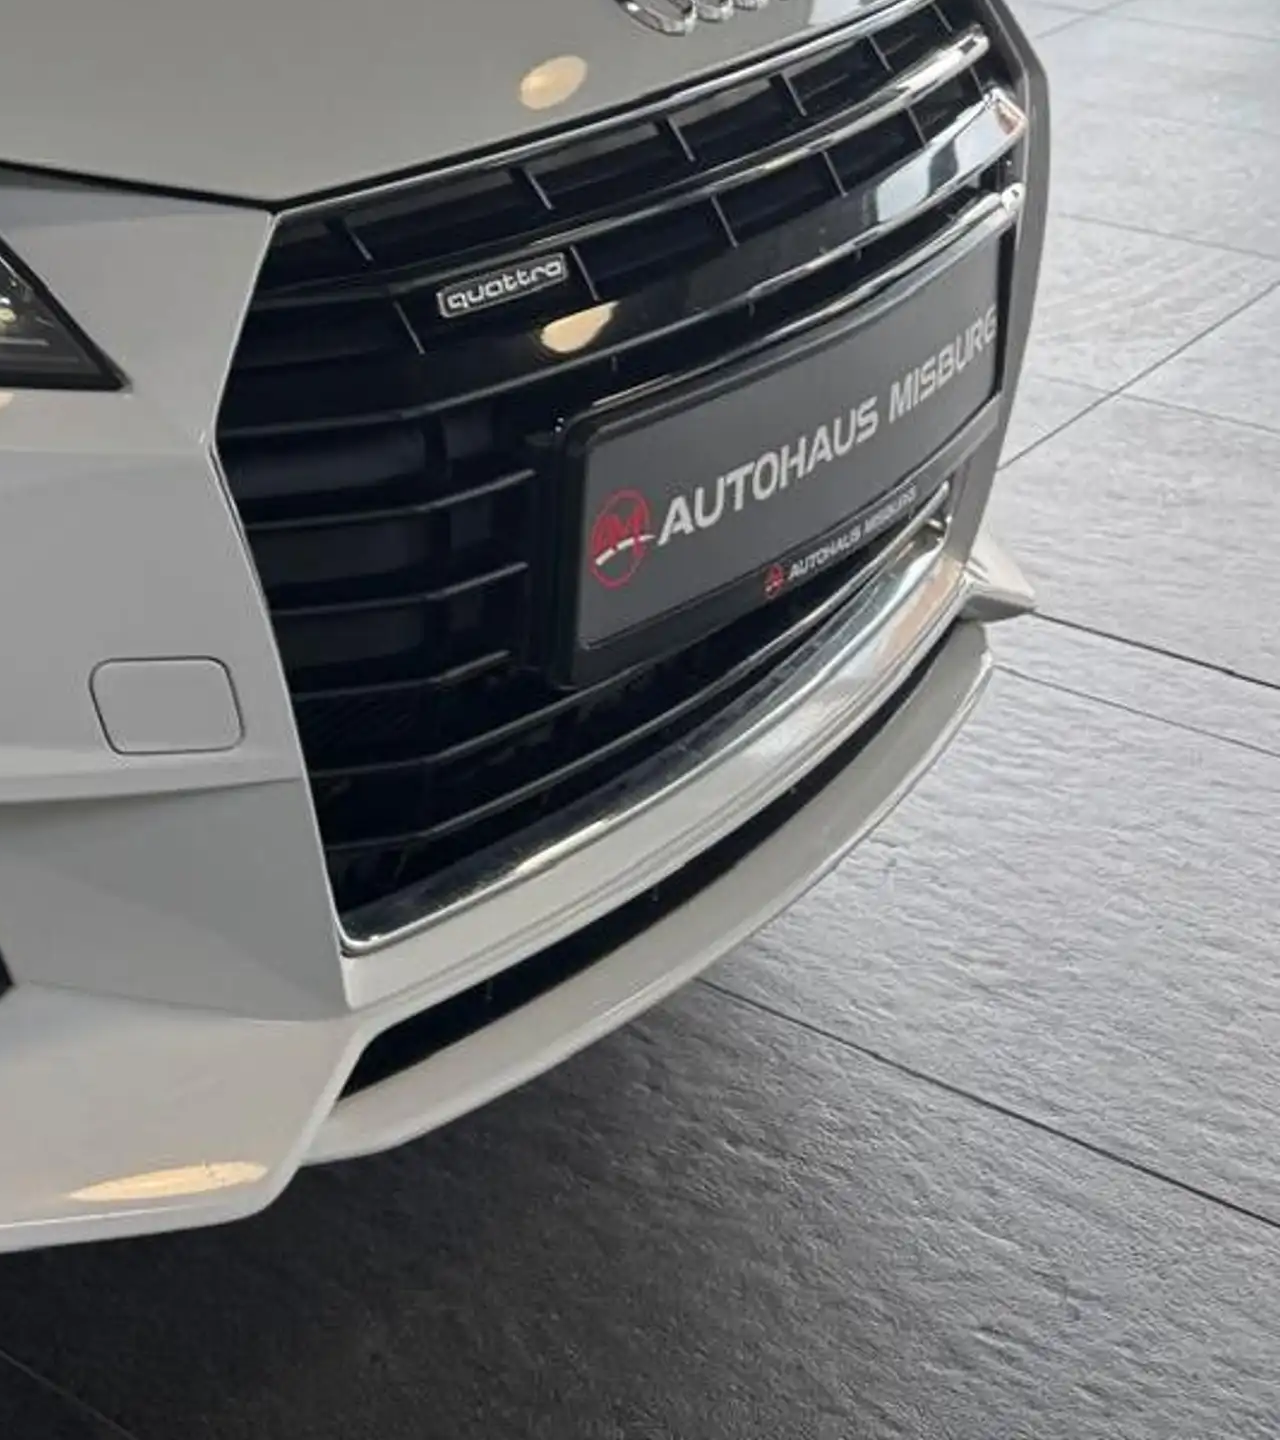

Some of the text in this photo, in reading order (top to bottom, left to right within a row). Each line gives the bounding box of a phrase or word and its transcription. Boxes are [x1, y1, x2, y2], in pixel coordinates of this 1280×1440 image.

[446, 259, 563, 309] quattro
[656, 396, 879, 547] AUTOHAUS
[887, 303, 998, 425] MISBURG
[787, 523, 862, 581] AUTOHAUS
